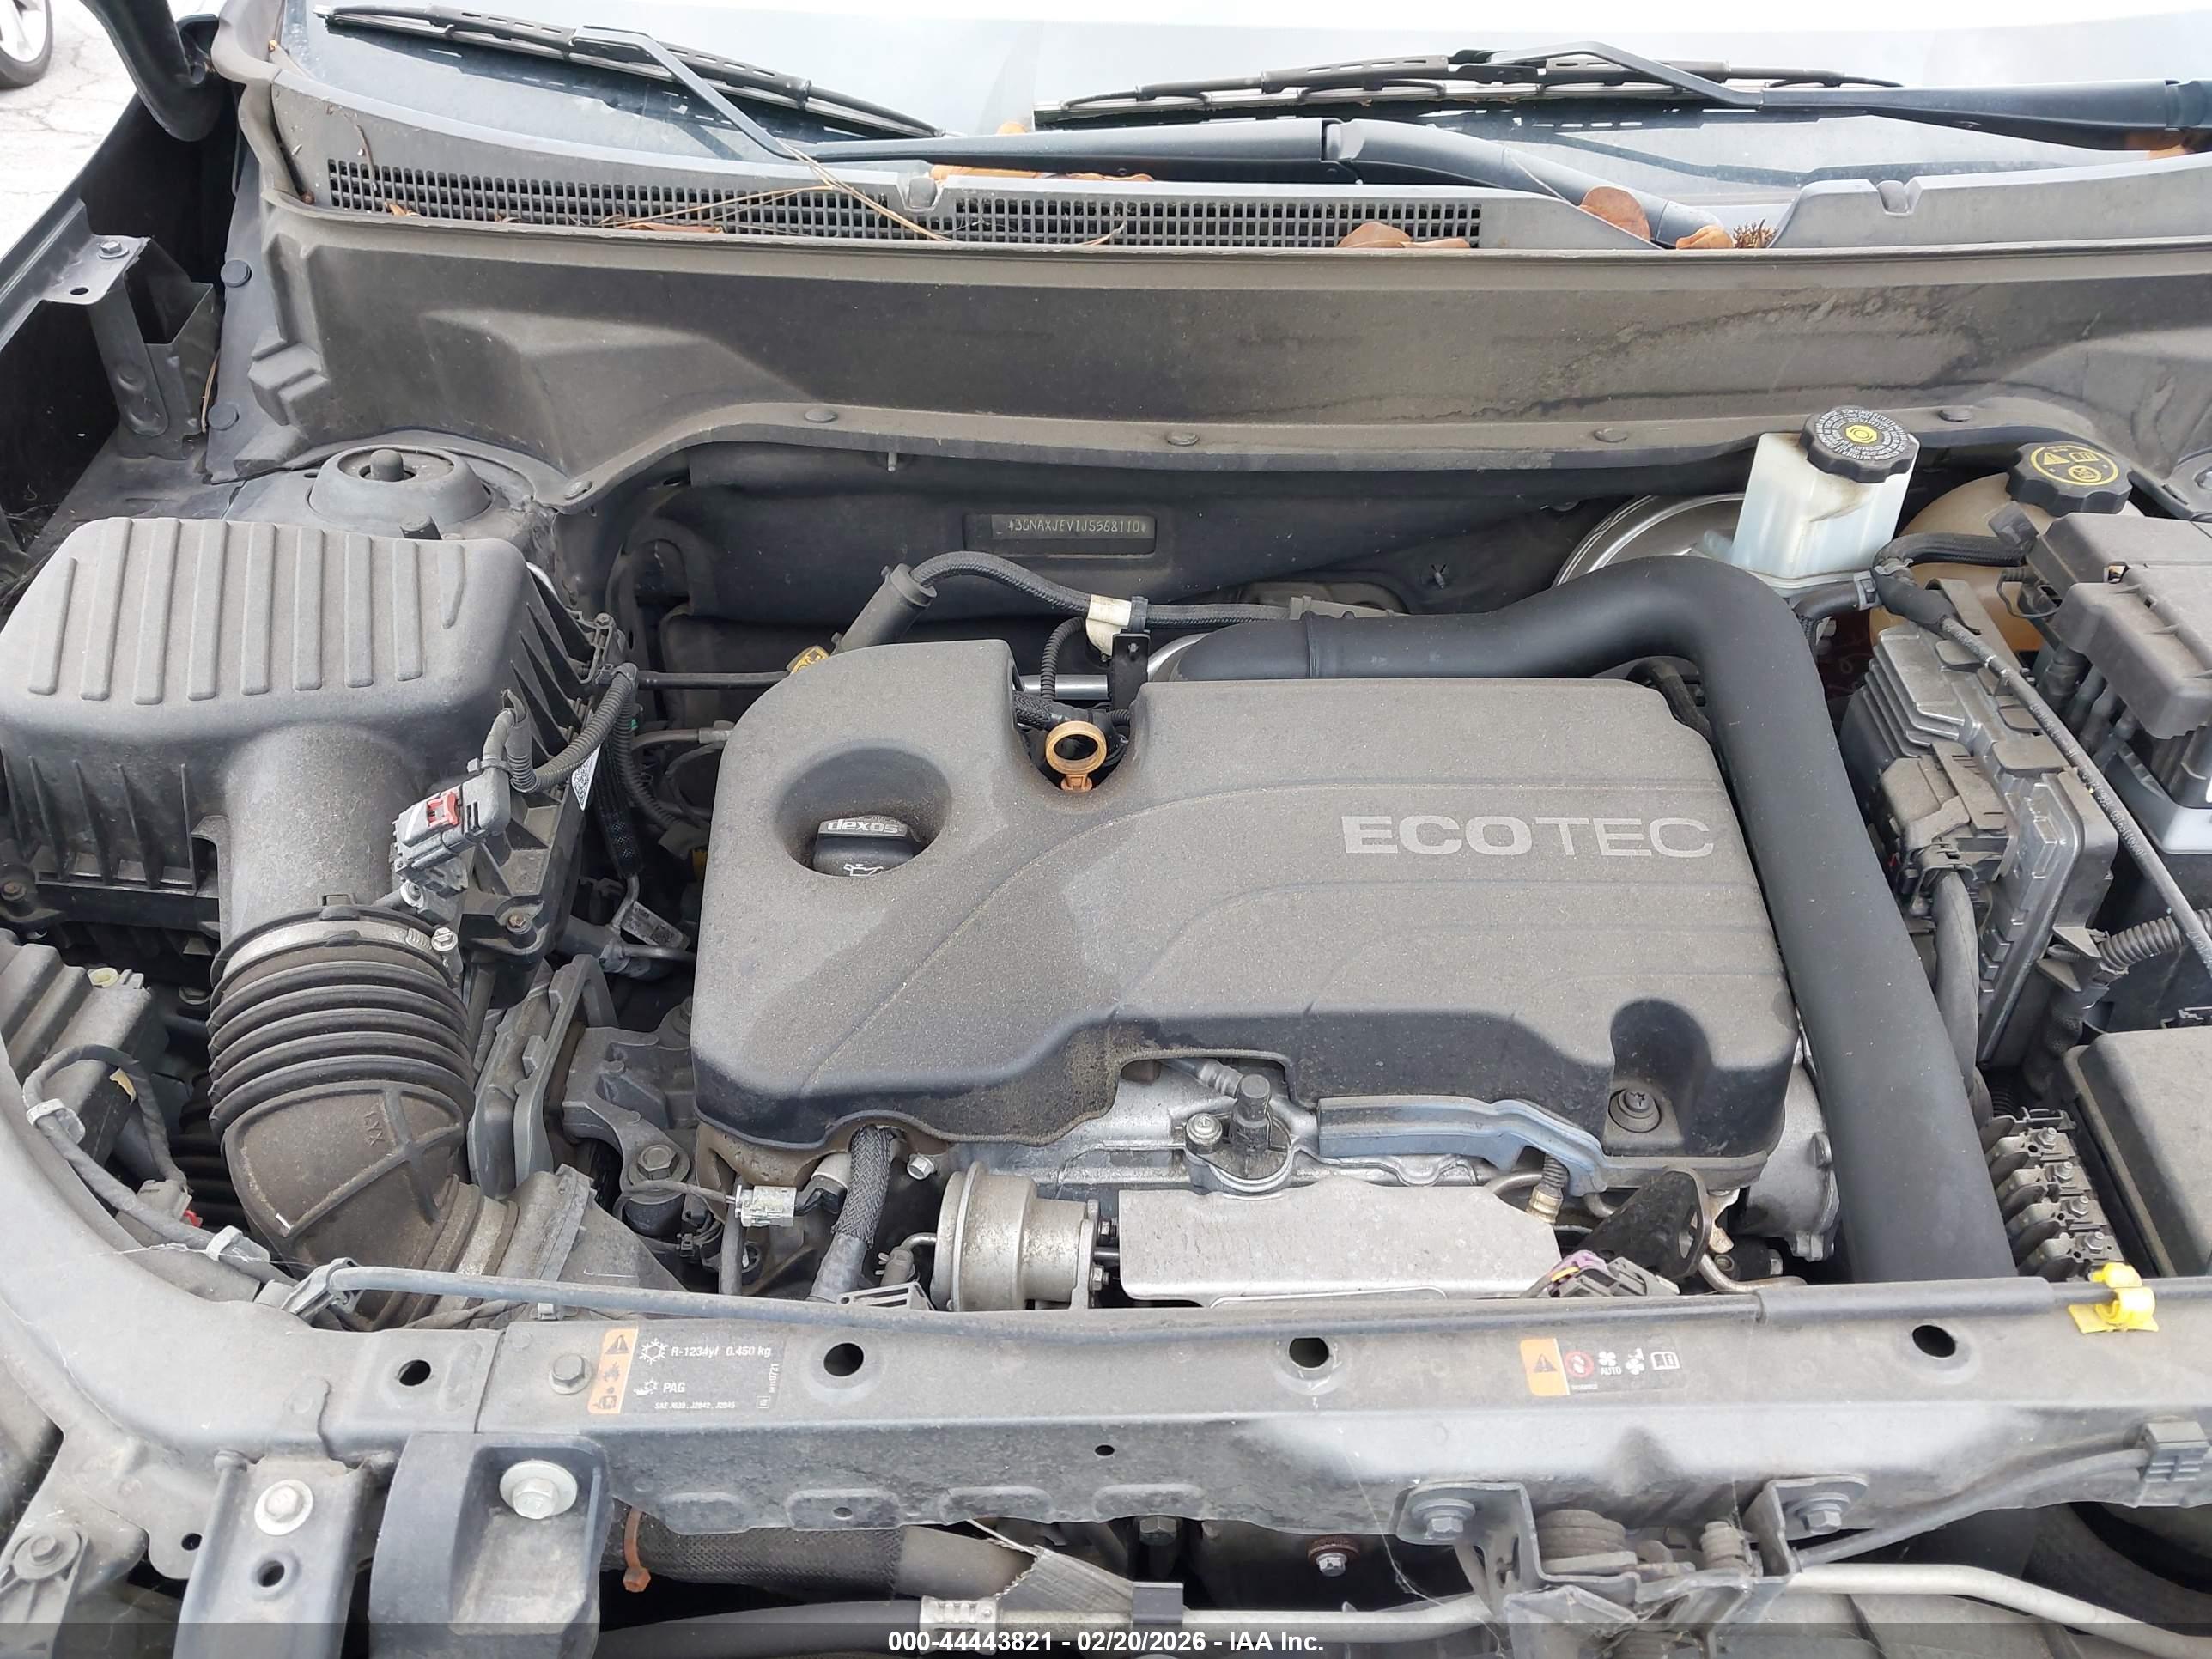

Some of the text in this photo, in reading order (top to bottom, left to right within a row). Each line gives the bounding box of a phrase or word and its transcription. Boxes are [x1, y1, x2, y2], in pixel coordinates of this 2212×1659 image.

[827, 818, 898, 833] dexos
[1341, 815, 1714, 857] ECOTEC
[671, 1346, 771, 1358] R-1234yf 0.450 kg
[1600, 1366, 1622, 1376] AUTO
[663, 1382, 686, 1393] PAG
